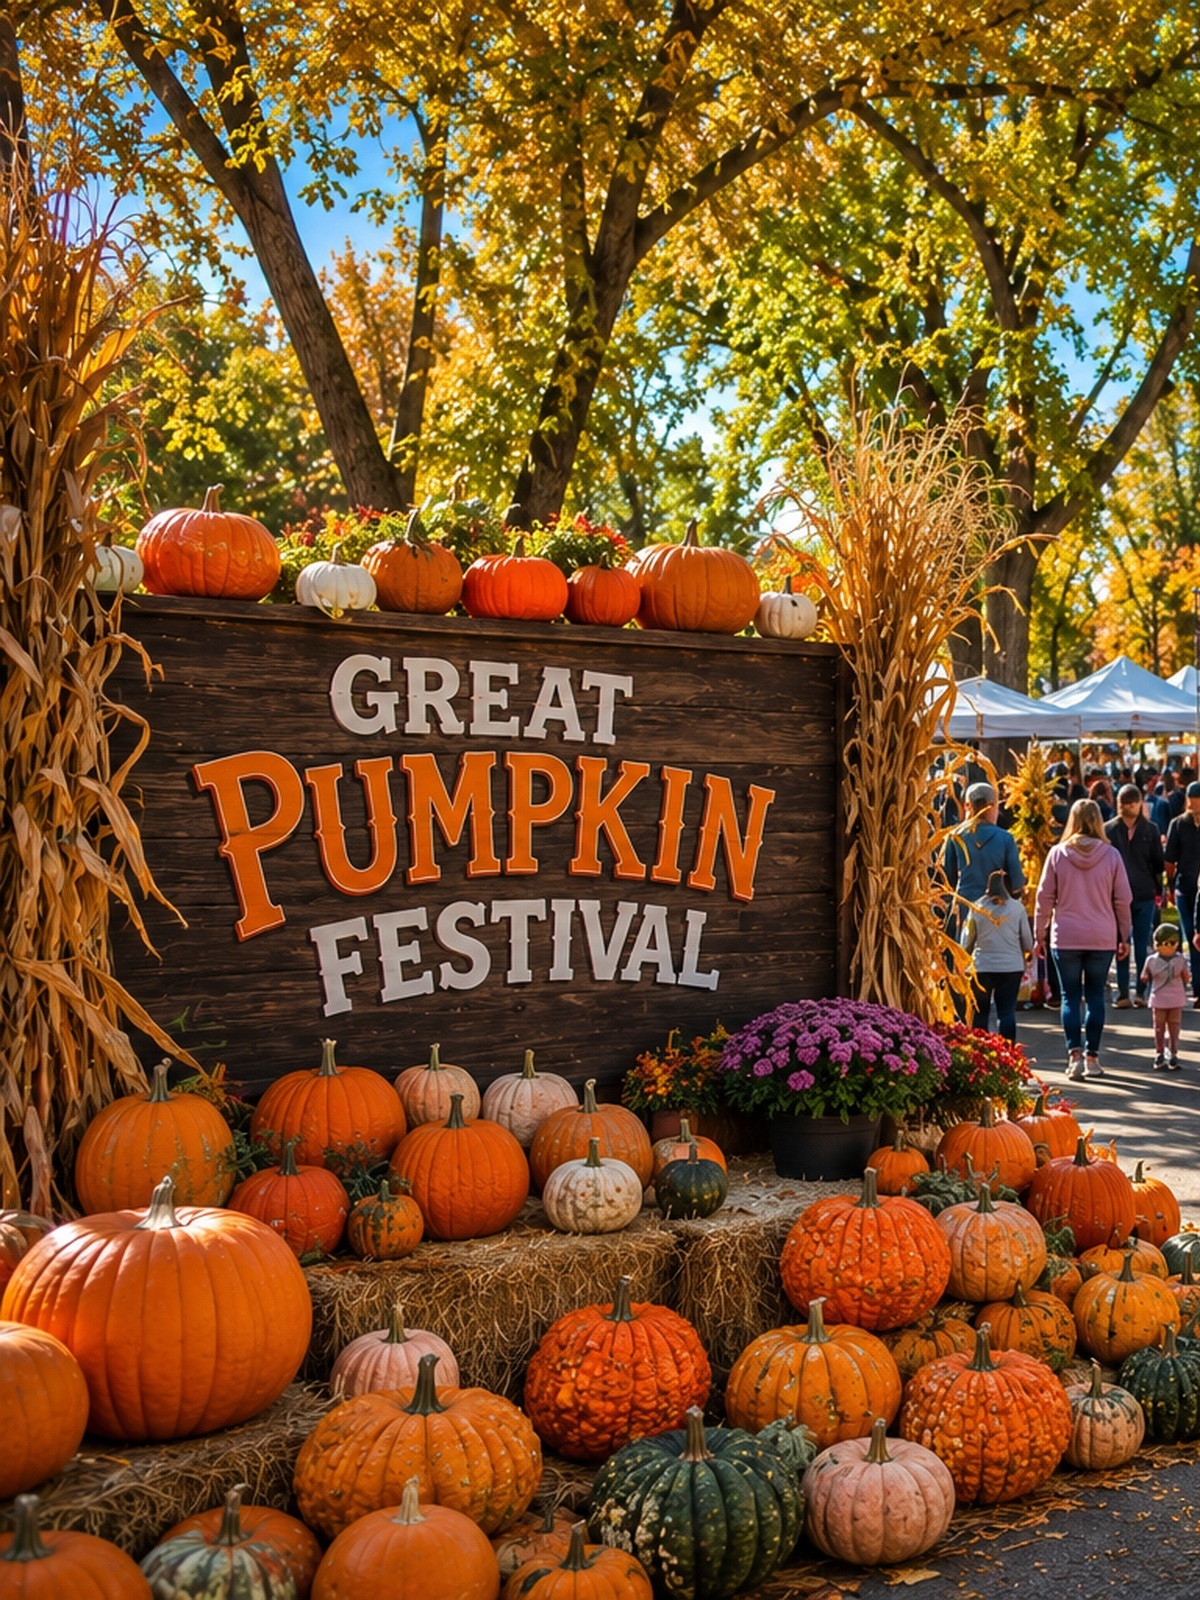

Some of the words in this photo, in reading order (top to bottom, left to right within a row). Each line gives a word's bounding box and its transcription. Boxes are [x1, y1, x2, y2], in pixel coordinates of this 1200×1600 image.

[329, 653, 634, 746] GREAT
[191, 749, 777, 942] PUMPKIN
[309, 898, 720, 1018] FESTIVAL
